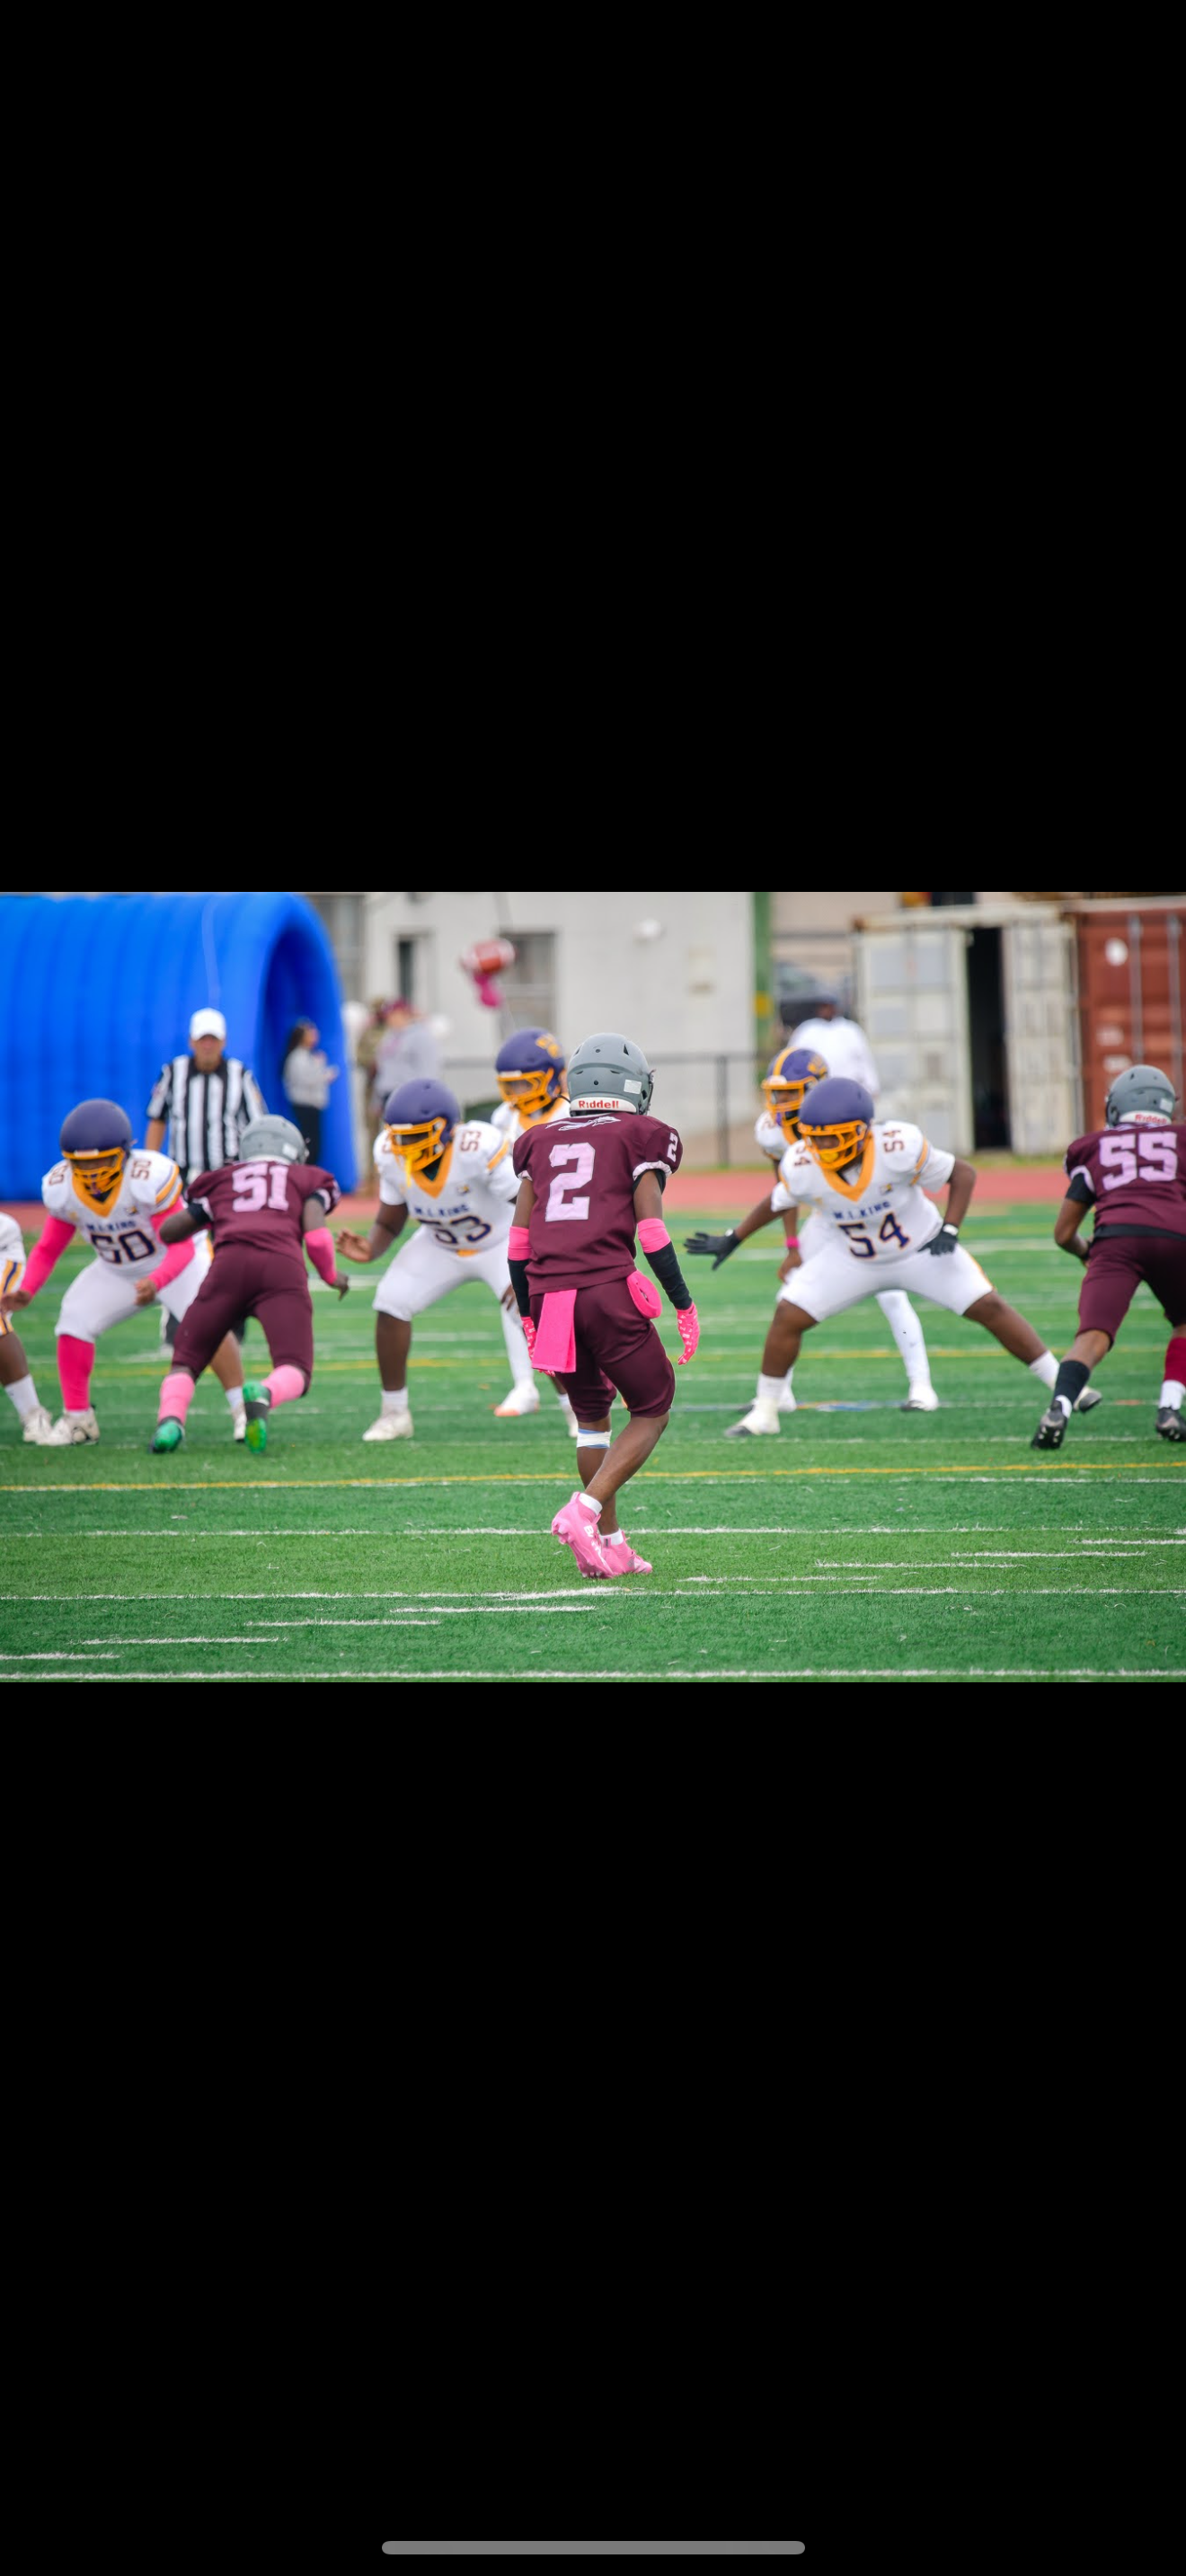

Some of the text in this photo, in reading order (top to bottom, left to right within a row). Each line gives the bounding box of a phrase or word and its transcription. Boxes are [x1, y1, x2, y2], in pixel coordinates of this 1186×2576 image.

[579, 1100, 619, 1109] Riddell
[460, 1131, 481, 1151] 53
[667, 1133, 678, 1162] 2
[882, 1129, 905, 1153] 54
[131, 1159, 152, 1180] 50
[1100, 1132, 1177, 1190] 55
[232, 1163, 288, 1212] 51
[545, 1142, 596, 1222] 2
[838, 1213, 909, 1258] 54
